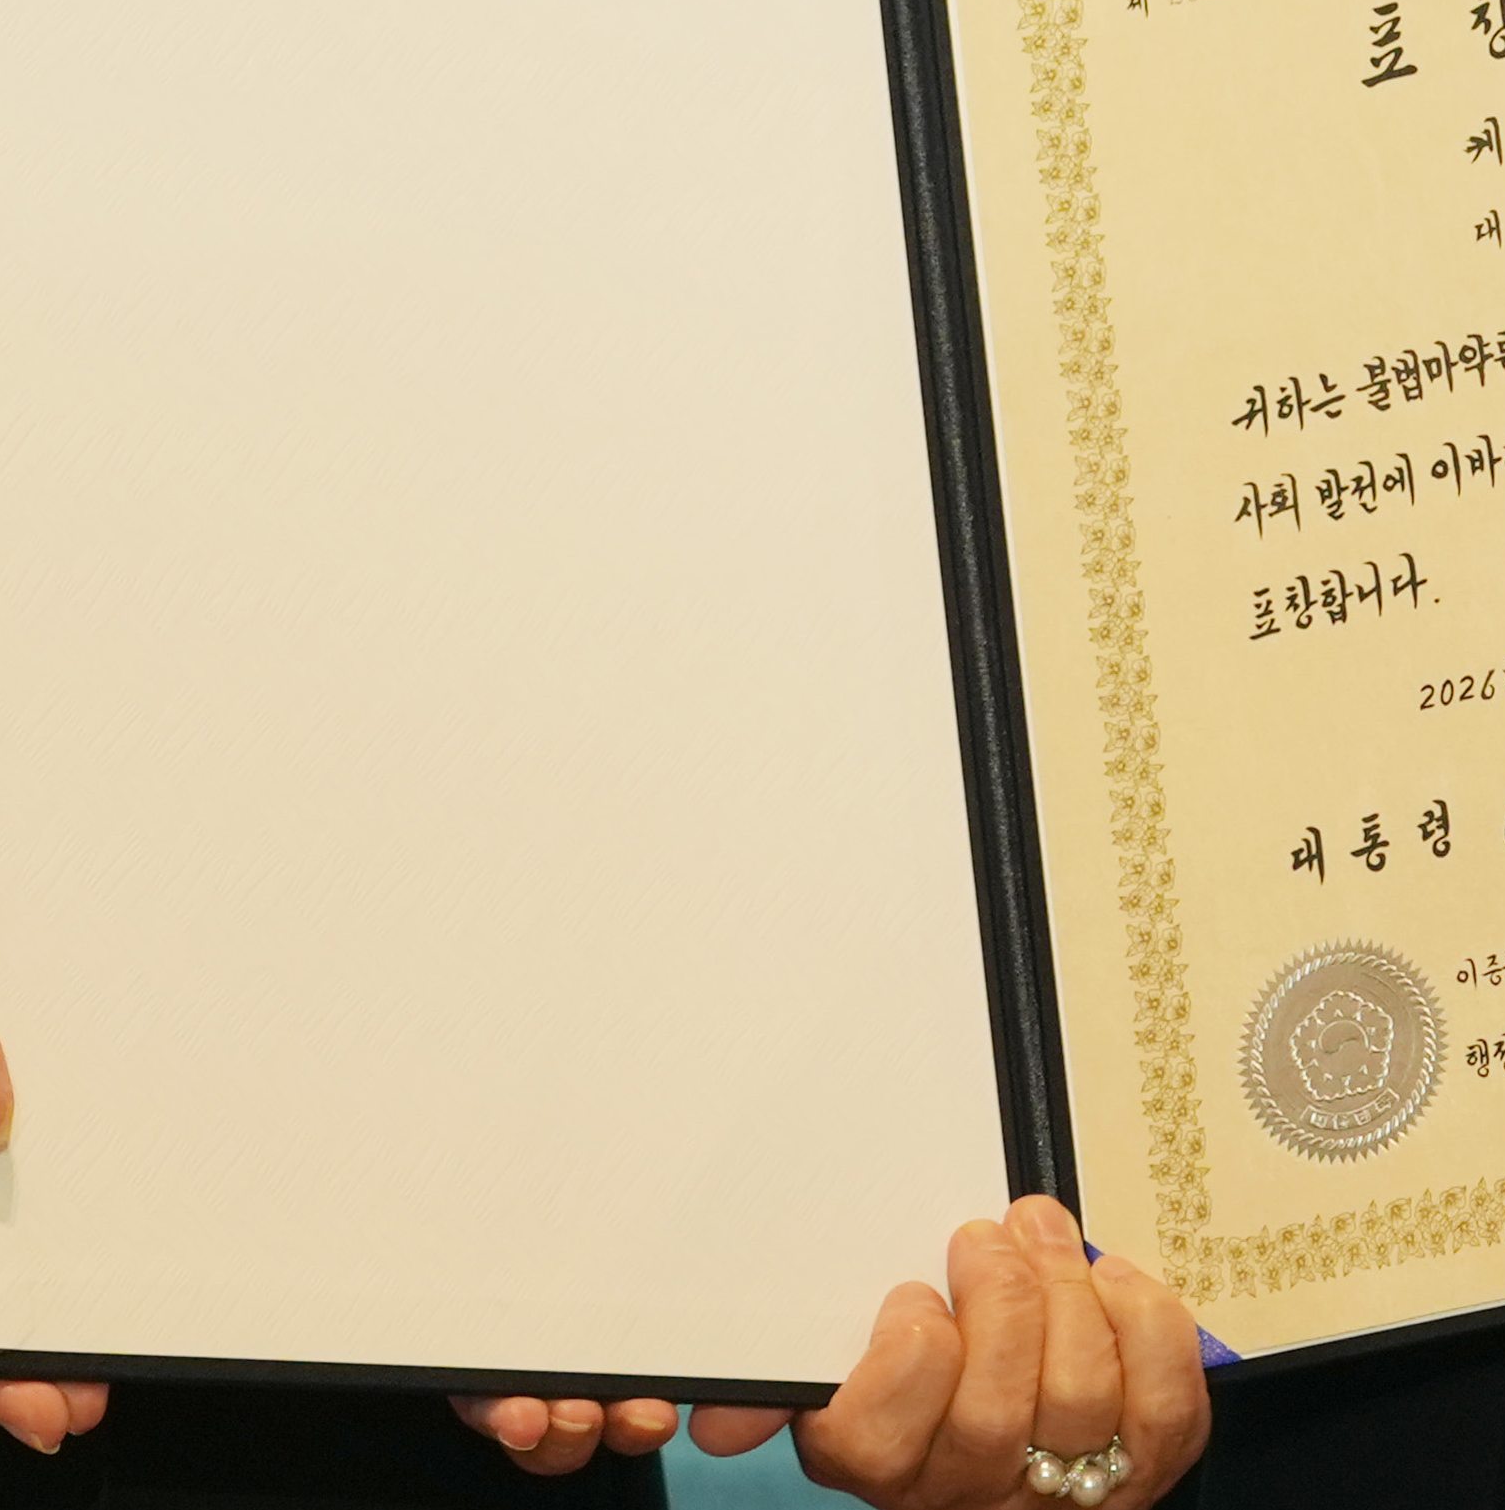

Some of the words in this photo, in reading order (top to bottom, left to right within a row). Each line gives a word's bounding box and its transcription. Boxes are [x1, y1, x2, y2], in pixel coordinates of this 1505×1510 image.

[1232, 373, 1348, 437] 귀하는
[1233, 472, 1301, 540] 사회
[1316, 452, 1416, 521] 발전에
[1248, 552, 1442, 642] 표창합니다.
[1456, 958, 1477, 989] 이
